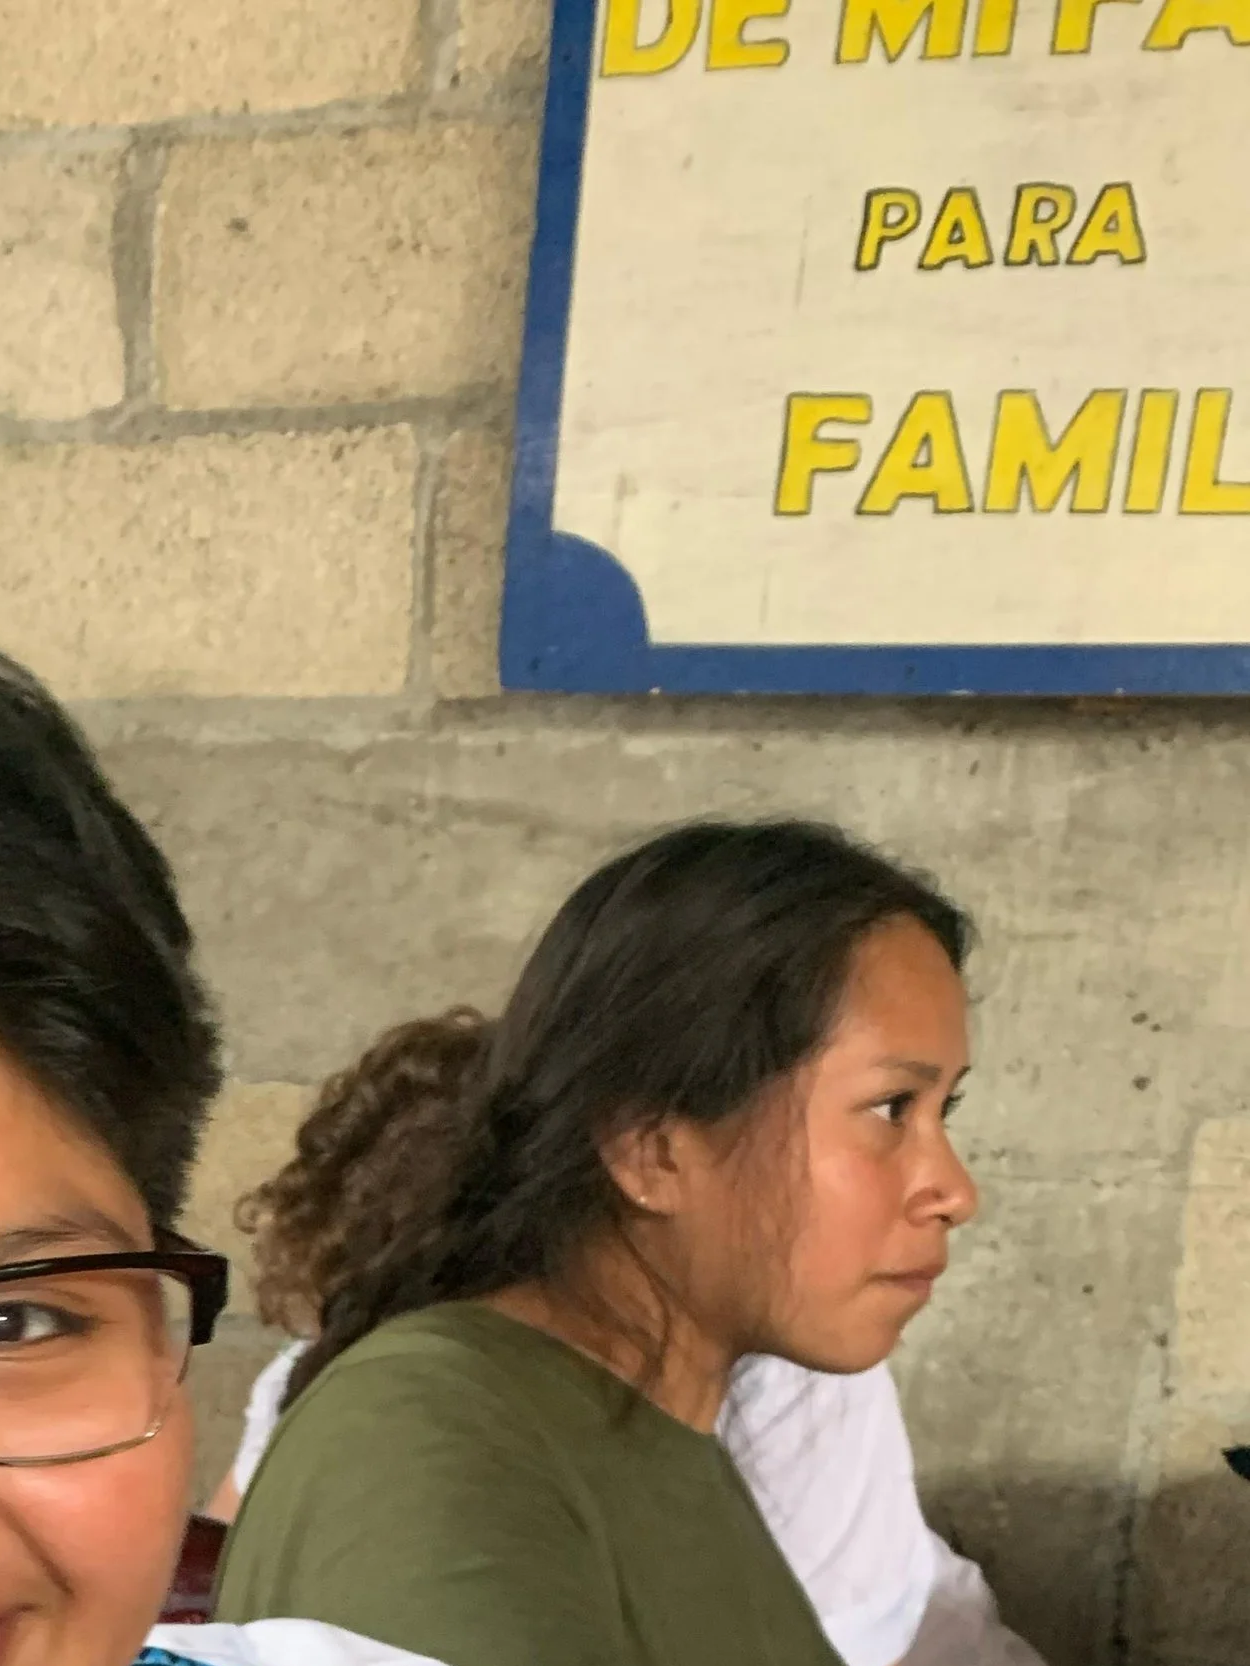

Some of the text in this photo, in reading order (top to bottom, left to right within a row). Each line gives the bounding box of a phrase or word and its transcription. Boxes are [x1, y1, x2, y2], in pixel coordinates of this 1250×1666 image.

[599, 0, 791, 77] DE
[853, 182, 1146, 271] PARA
[773, 386, 1250, 517] FAMIL
